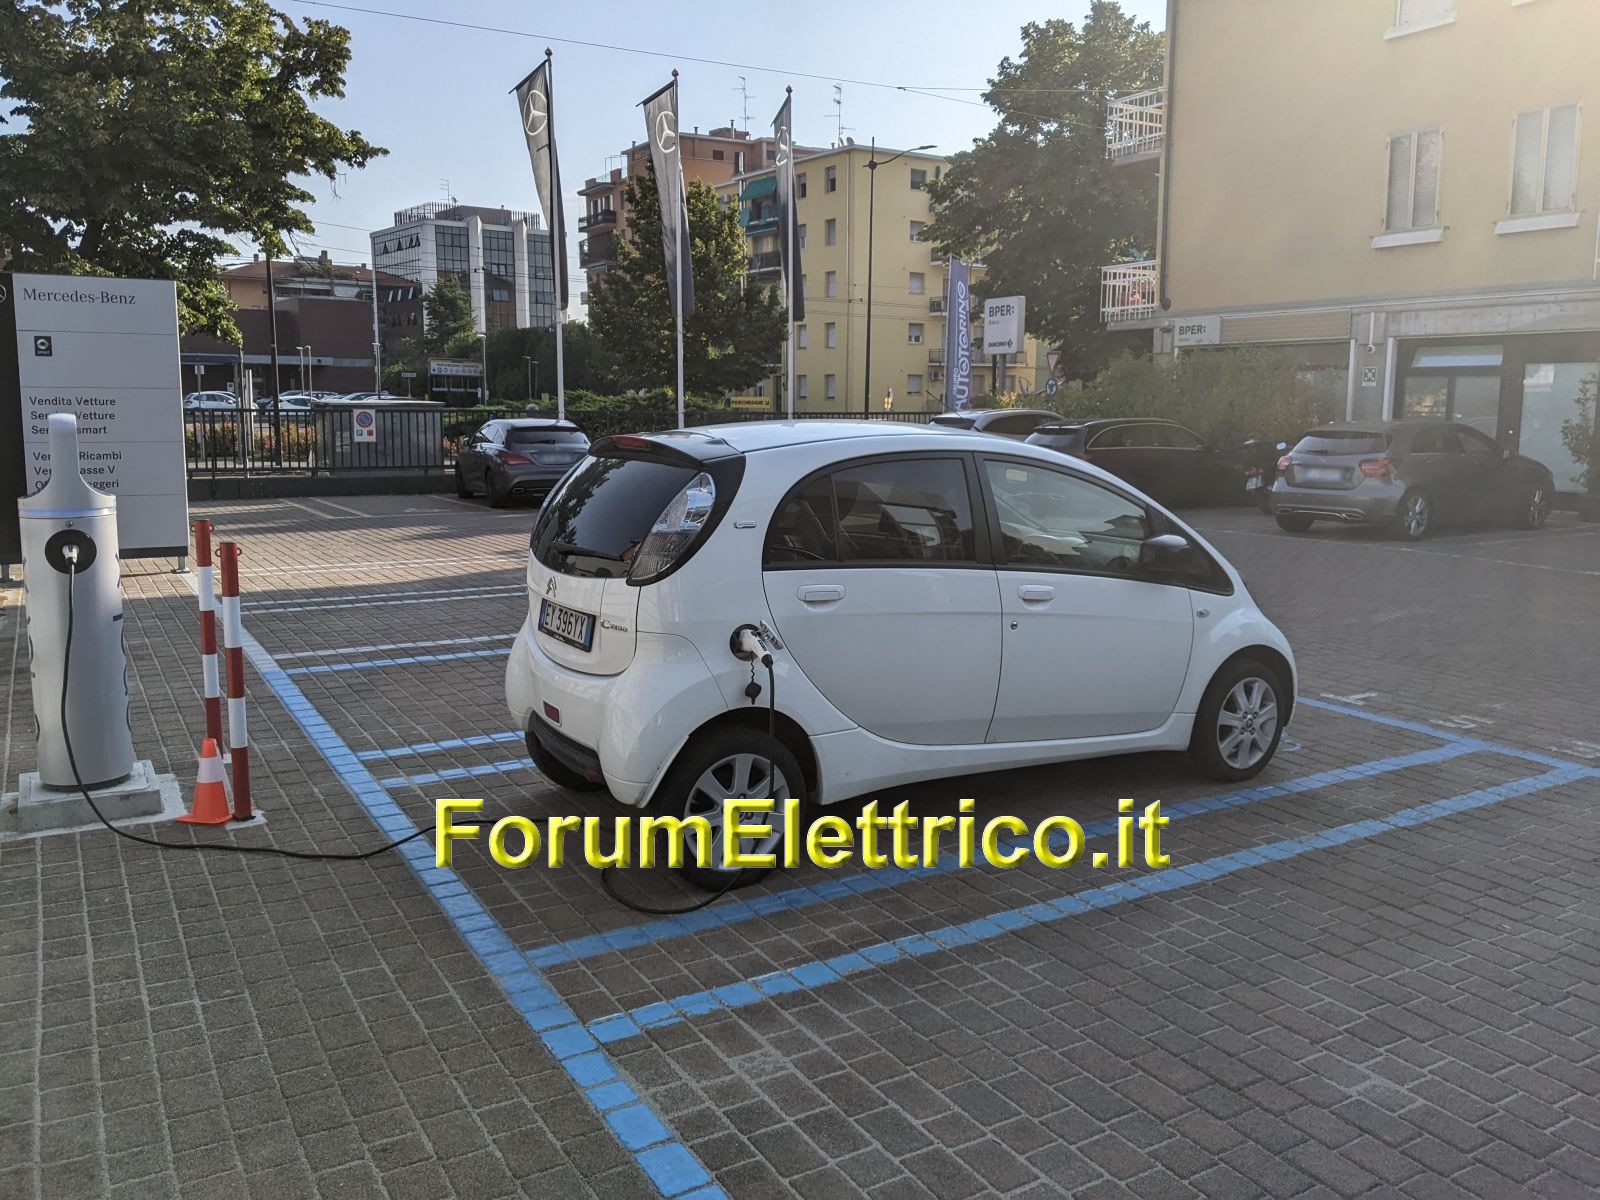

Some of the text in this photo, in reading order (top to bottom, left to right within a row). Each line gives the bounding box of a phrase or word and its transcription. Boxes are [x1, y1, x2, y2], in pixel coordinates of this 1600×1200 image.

[23, 288, 136, 304] Mercedes-Benz
[29, 396, 116, 406] Vendita Vetture
[74, 411, 116, 420] Vetture
[77, 426, 108, 435] smart
[80, 451, 122, 461] Ricambi
[107, 465, 116, 474] V
[544, 603, 586, 641] EY 396YX
